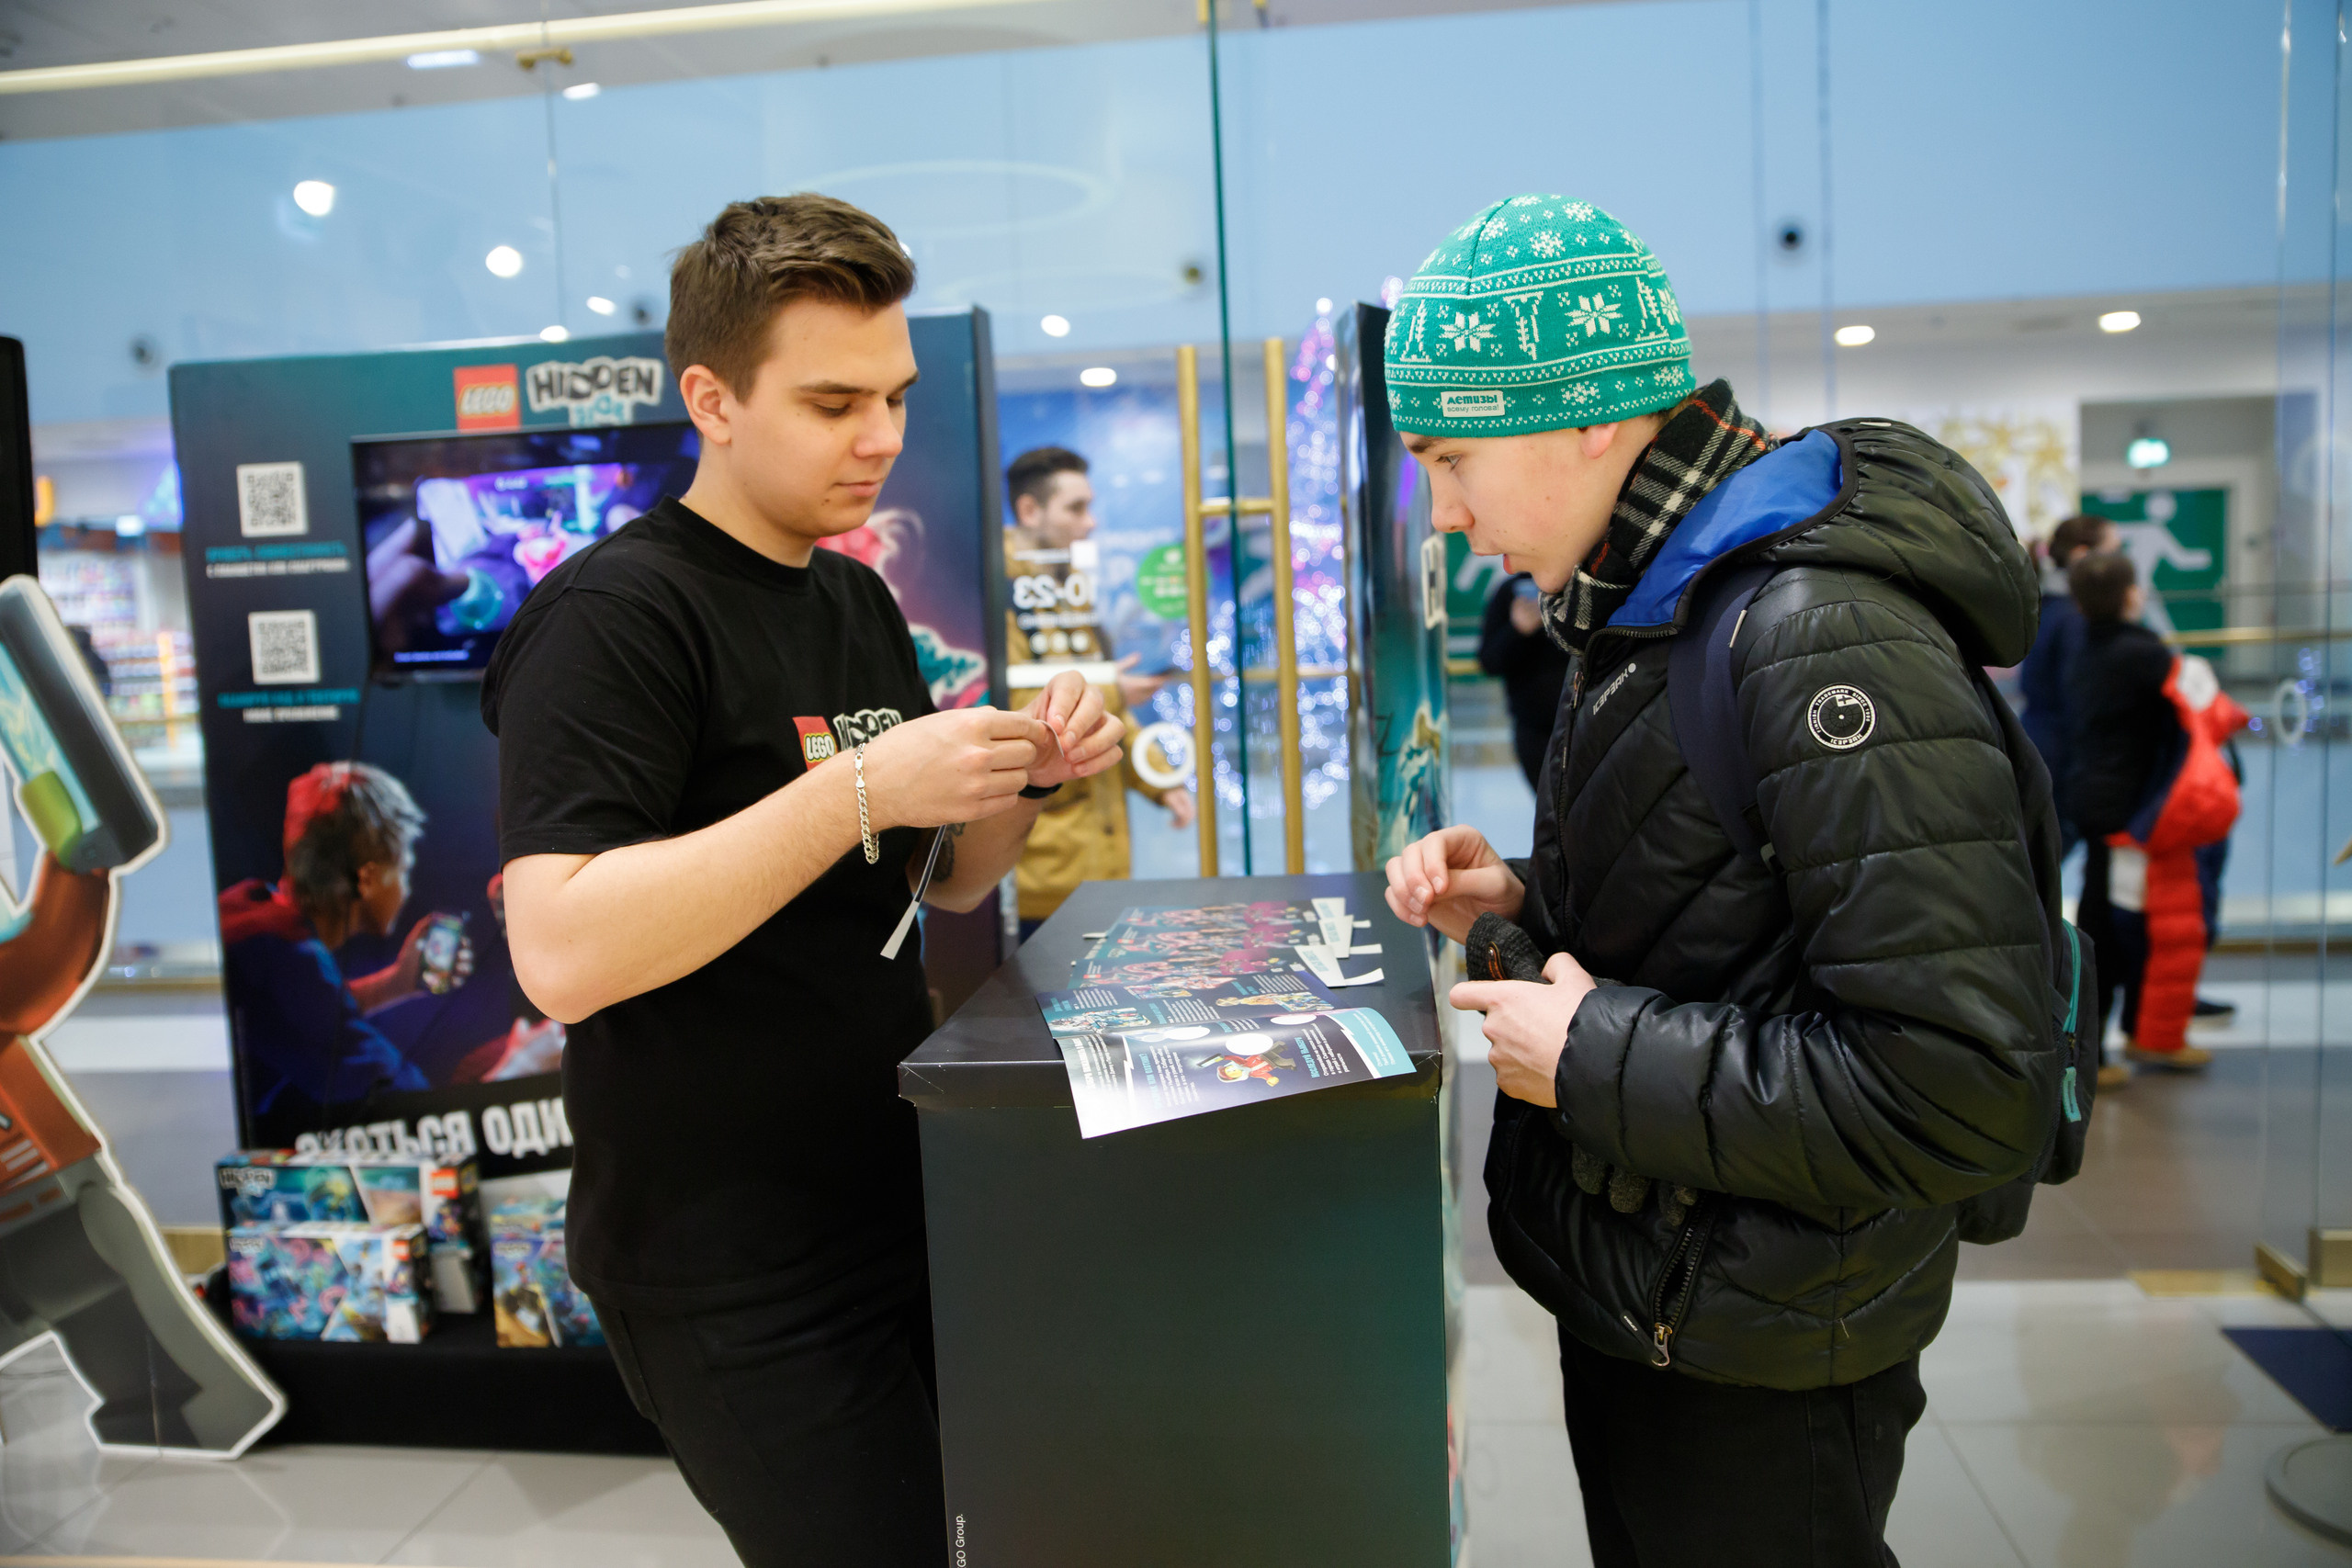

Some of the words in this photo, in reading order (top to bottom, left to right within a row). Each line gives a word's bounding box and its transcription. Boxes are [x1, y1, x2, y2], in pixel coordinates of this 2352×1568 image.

[530, 362, 659, 406] HIDDEN
[458, 384, 516, 416] LEGO
[1592, 668, 1629, 716] ICEPEAK
[1815, 689, 1849, 706] TRADEMARK
[1851, 692, 1868, 707] SINCE
[805, 734, 836, 761] LEGO
[1830, 733, 1863, 745] ICEPEAK
[956, 1514, 966, 1548] Group.
[956, 1550, 967, 1568] GO
